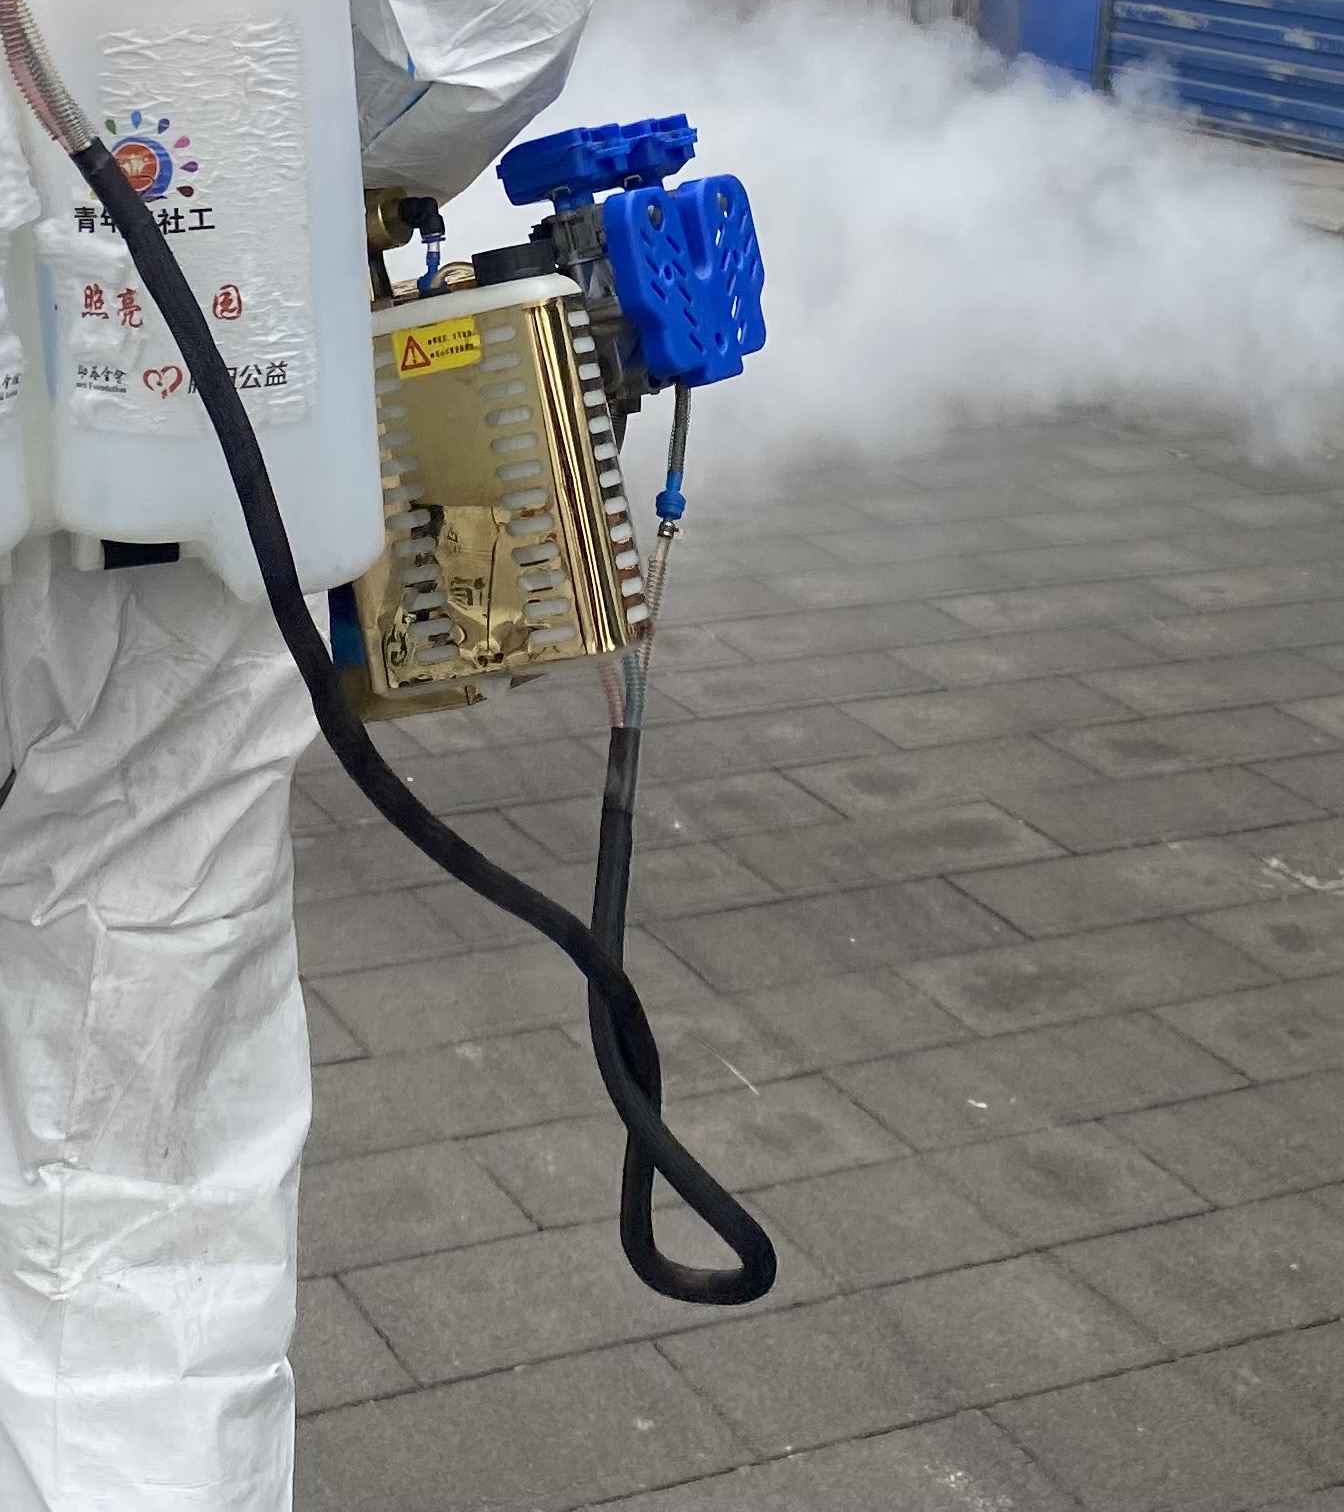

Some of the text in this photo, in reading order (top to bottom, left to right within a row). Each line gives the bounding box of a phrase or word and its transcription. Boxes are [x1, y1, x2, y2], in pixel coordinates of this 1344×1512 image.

[73, 206, 216, 236] 青年社工
[81, 282, 243, 329] 照亮园
